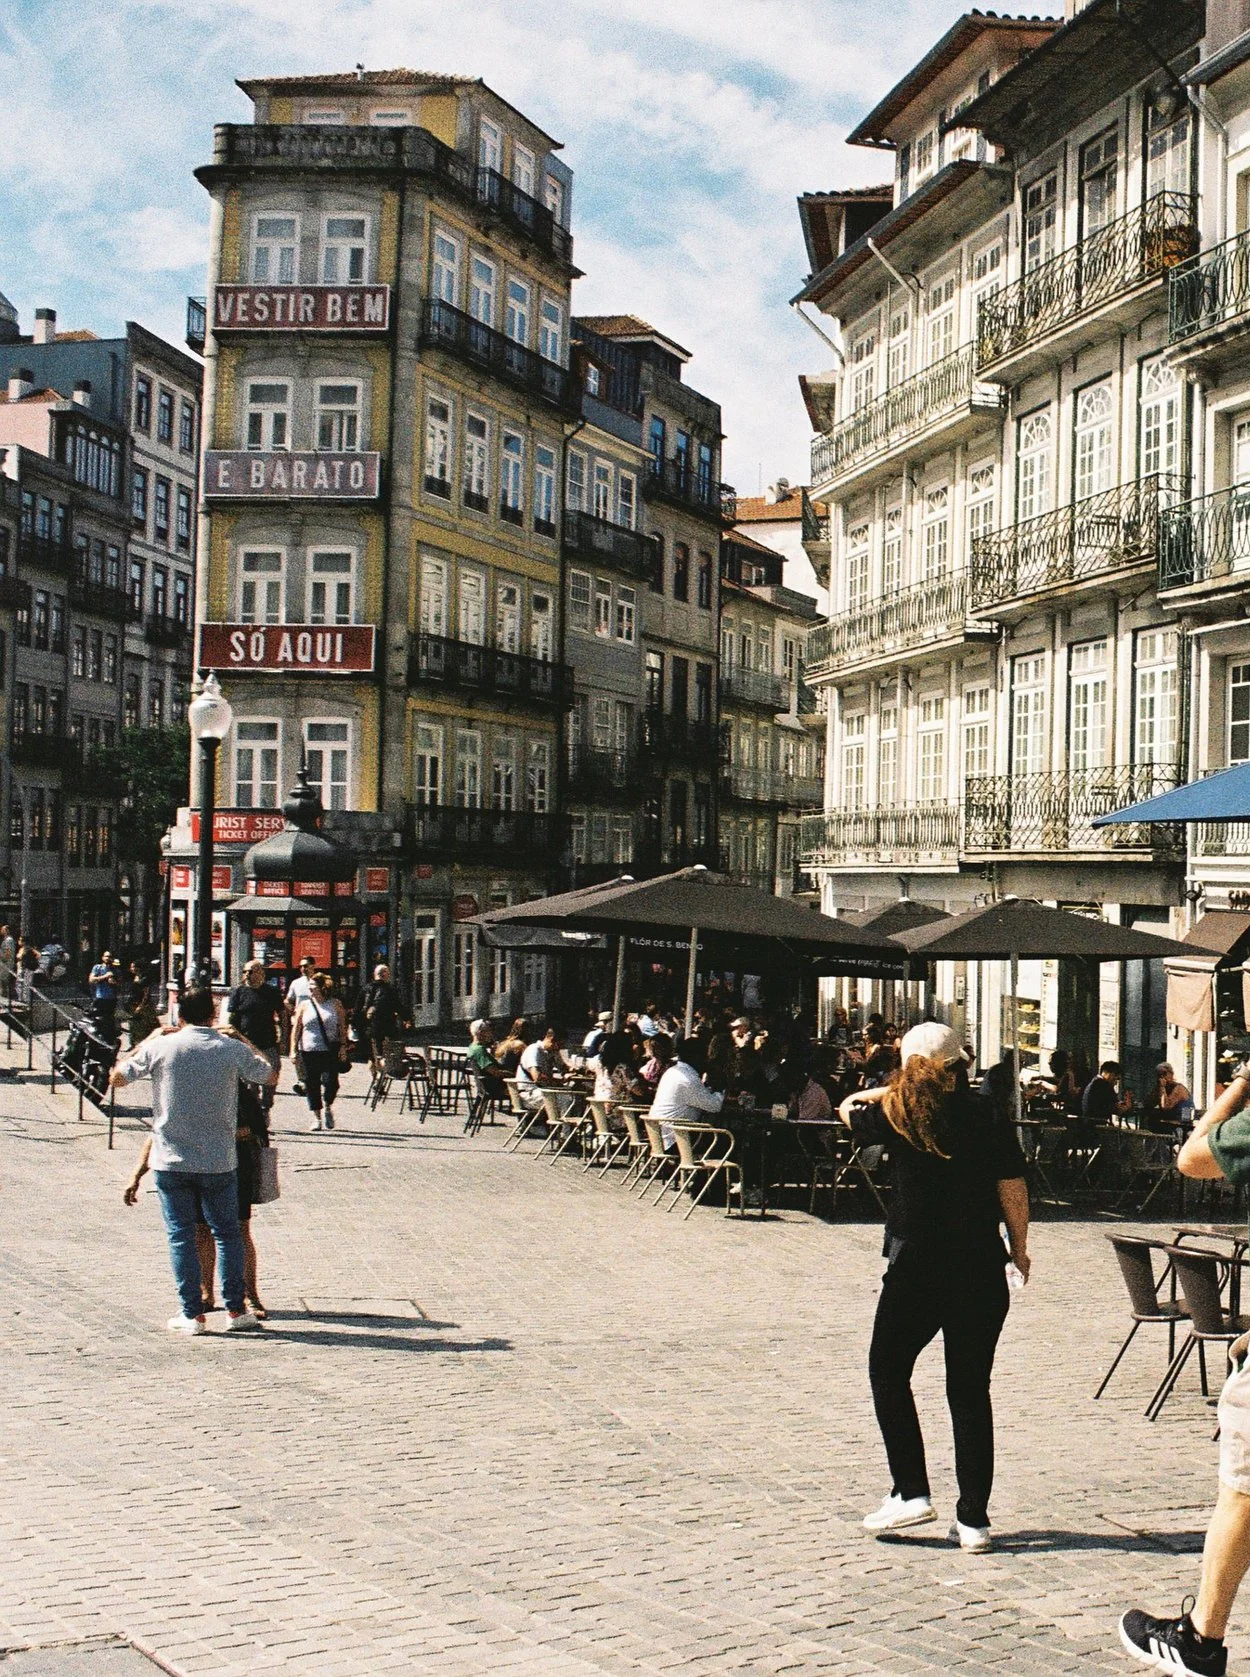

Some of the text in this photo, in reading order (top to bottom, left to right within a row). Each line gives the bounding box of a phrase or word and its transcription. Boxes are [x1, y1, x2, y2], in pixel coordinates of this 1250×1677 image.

[218, 292, 385, 323] VESTIR BEM
[218, 459, 364, 490] E BARATO
[230, 626, 343, 664] SÓ AQUI
[218, 830, 248, 839] TICKET
[653, 939, 665, 947] DE
